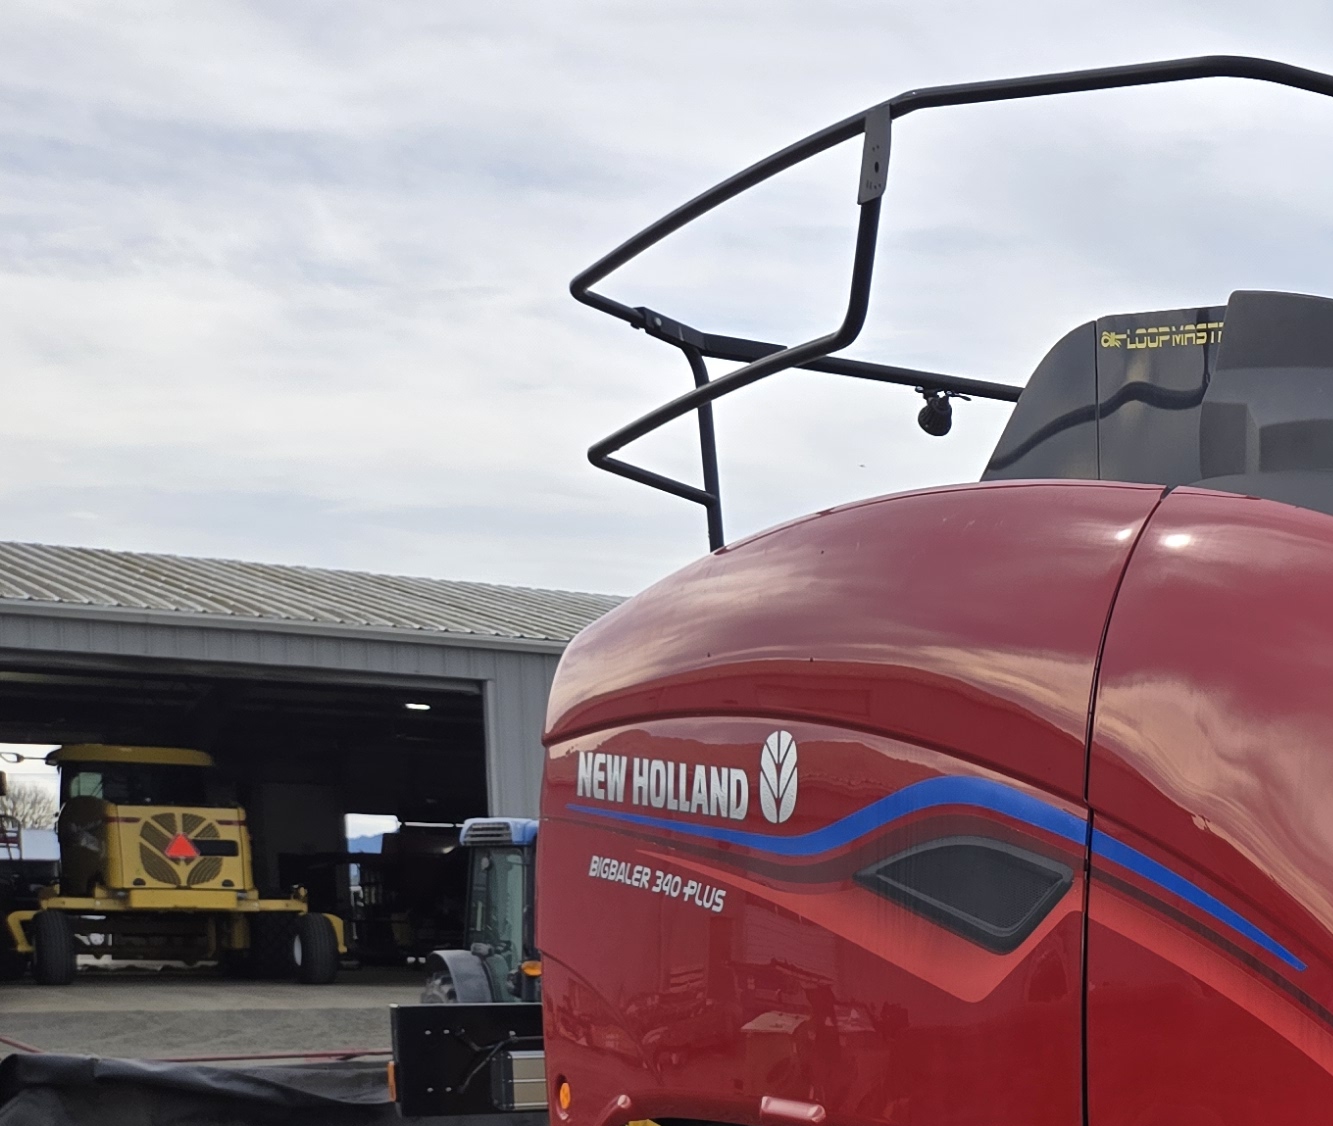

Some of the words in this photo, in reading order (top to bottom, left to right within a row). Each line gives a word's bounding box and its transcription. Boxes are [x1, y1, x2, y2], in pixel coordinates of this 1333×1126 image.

[577, 751, 627, 802] NEW
[632, 757, 749, 820] HOLLAND
[588, 855, 652, 889] BIGBALER
[651, 870, 682, 898] 340
